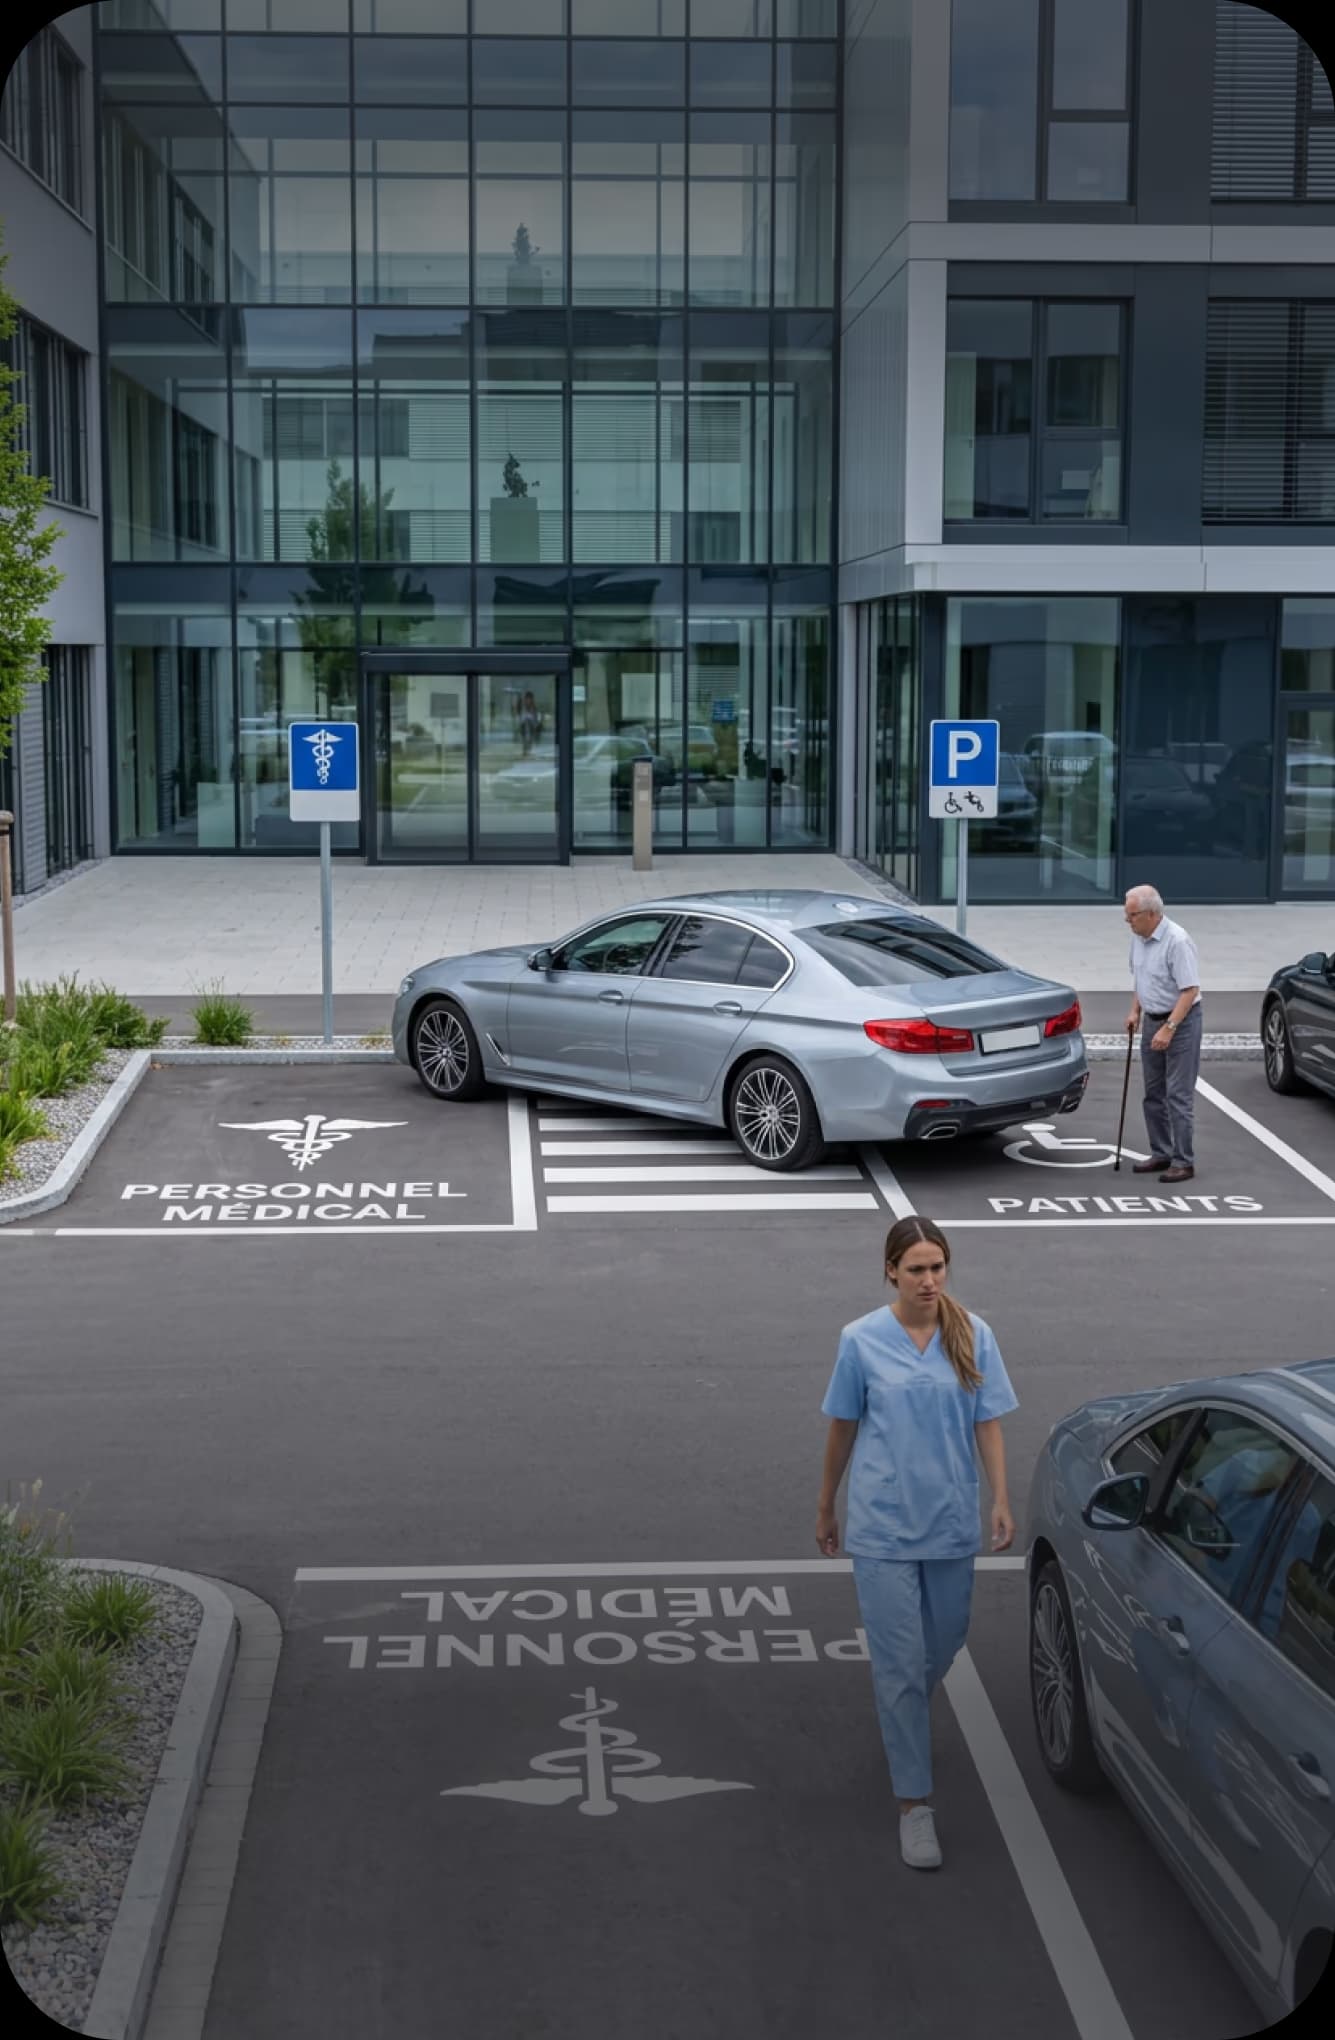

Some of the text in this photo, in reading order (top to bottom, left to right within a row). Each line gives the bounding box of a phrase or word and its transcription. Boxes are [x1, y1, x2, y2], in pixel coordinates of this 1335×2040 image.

[948, 730, 982, 778] P
[120, 1182, 468, 1200] PERSONNEL
[987, 1195, 1264, 1213] PATIENTS
[161, 1201, 427, 1221] MÉDICAL
[400, 1585, 793, 1628] MÉDICAL
[322, 1627, 873, 1669] PERSONNEL
